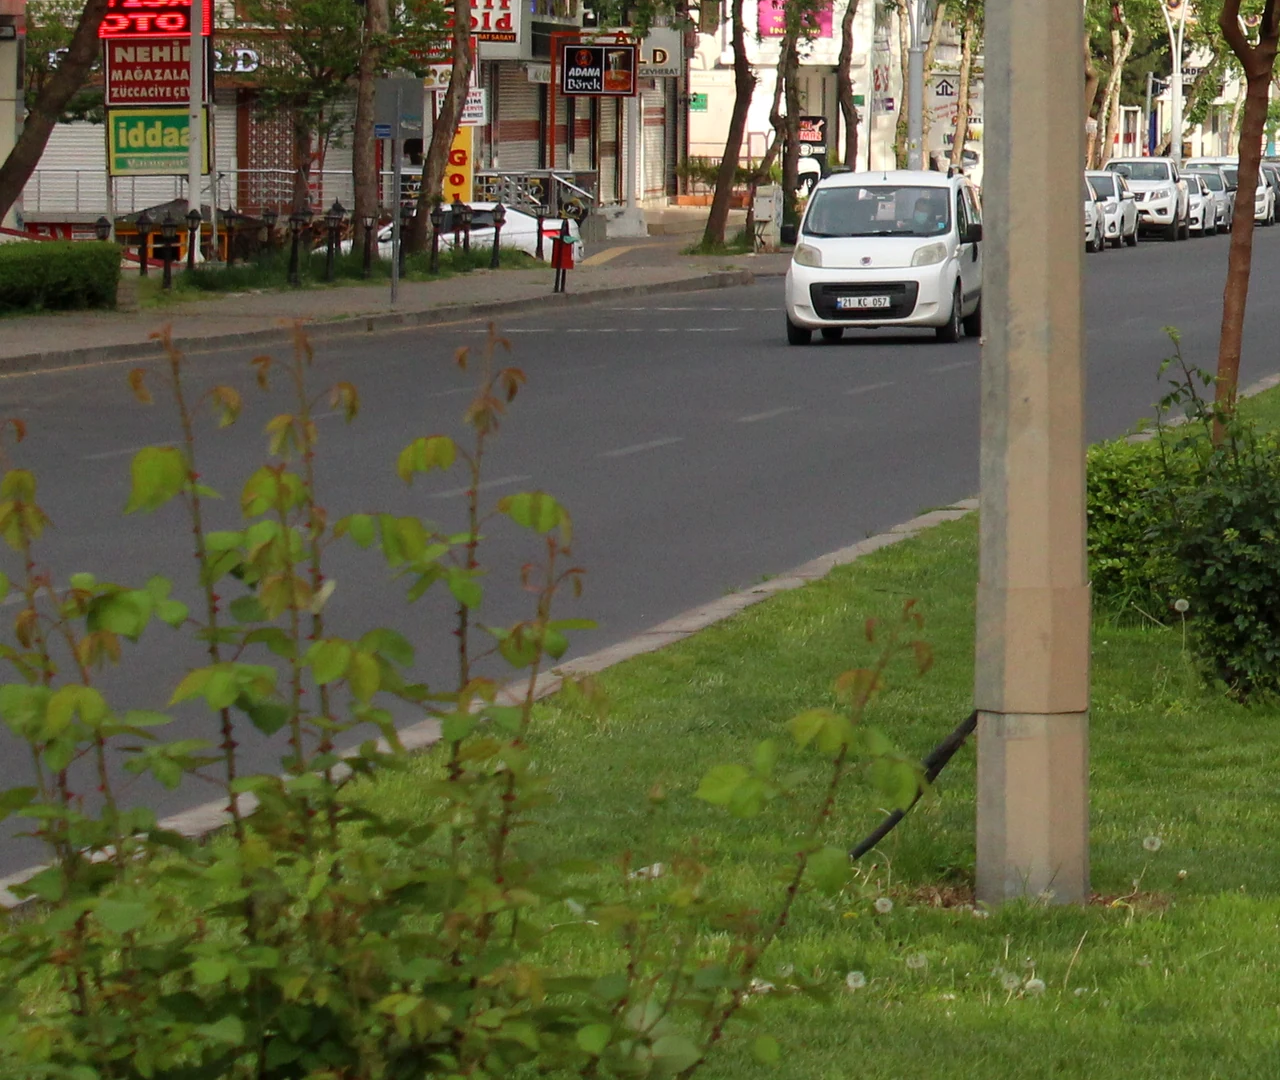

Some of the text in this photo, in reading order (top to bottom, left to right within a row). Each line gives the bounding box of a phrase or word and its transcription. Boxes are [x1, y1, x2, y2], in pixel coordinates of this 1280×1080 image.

[111, 66, 190, 81] MAĞAZALA
[569, 67, 600, 77] ADANA
[567, 79, 600, 90] Börek
[111, 84, 172, 98] ZÜCCACİYE
[843, 298, 852, 307] 21
